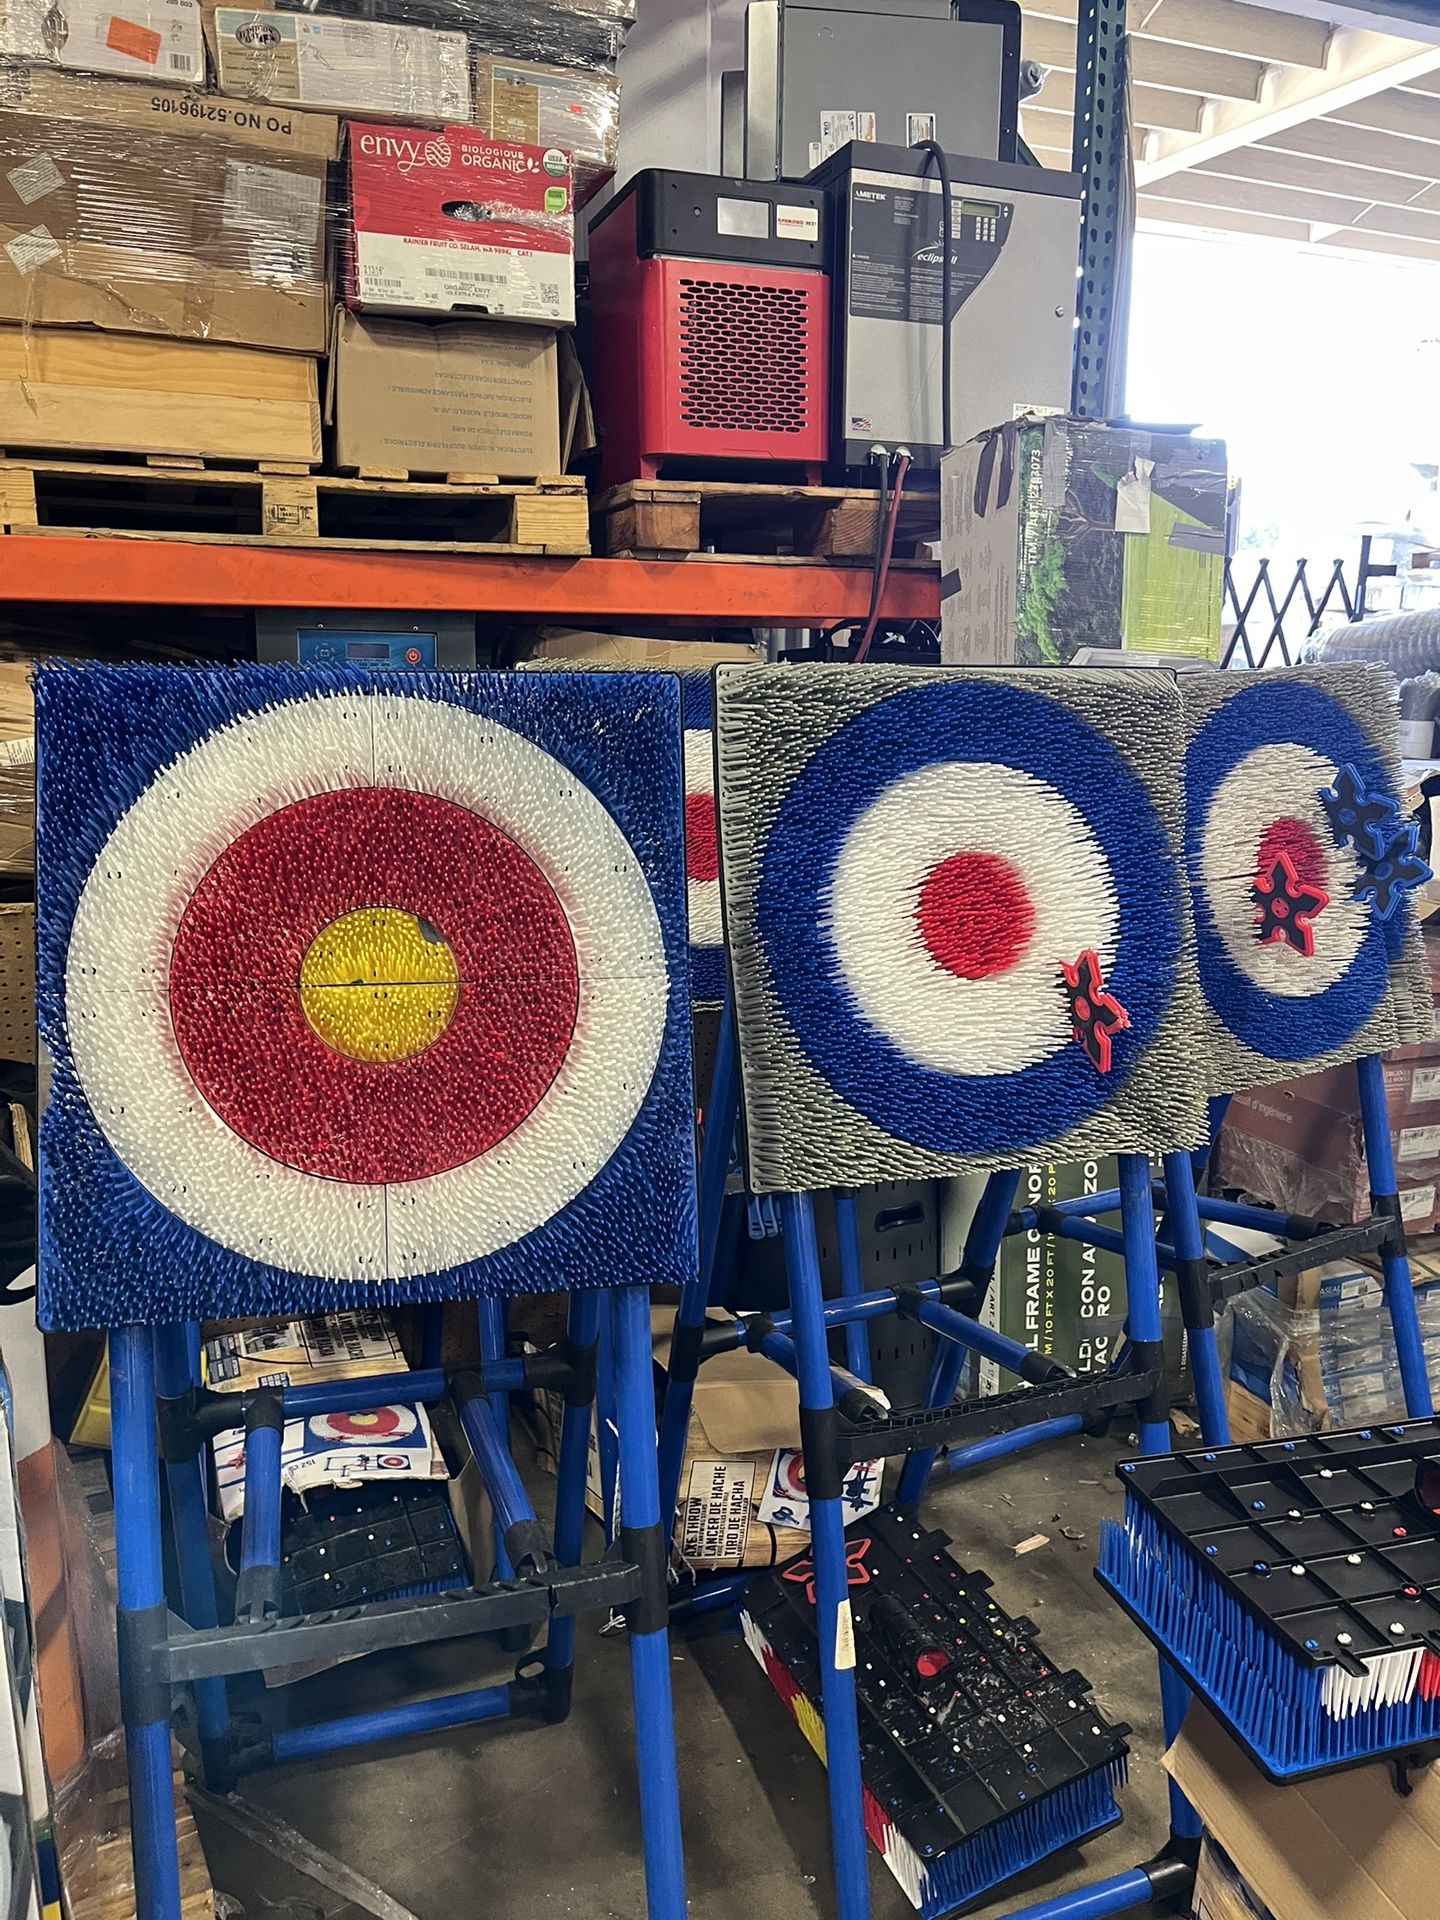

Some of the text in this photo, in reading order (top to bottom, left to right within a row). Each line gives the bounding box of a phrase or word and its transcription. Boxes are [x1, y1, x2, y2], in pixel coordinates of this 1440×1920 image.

[151, 97, 292, 135] PO NO.52196105
[360, 134, 426, 173] envy
[461, 144, 524, 160] BIOLOGIQUE
[461, 154, 527, 173] ORGANIC
[854, 190, 886, 201] AMETEK
[429, 240, 447, 249] FRUIT
[917, 252, 944, 265] eclips
[1048, 1178, 1056, 1195] 20
[1046, 1251, 1055, 1265] FT
[1046, 1269, 1055, 1287] 20
[1026, 1246, 1041, 1330] FRAME
[1045, 1291, 1054, 1299] X
[1080, 1269, 1095, 1318] CON
[1045, 1303, 1054, 1317] FT
[1044, 1319, 1053, 1334] 10
[704, 1466, 726, 1556] LANCER DE HACHE
[724, 1481, 745, 1556] TIRO DE HACHA
[685, 1497, 702, 1557] AXE THROW
